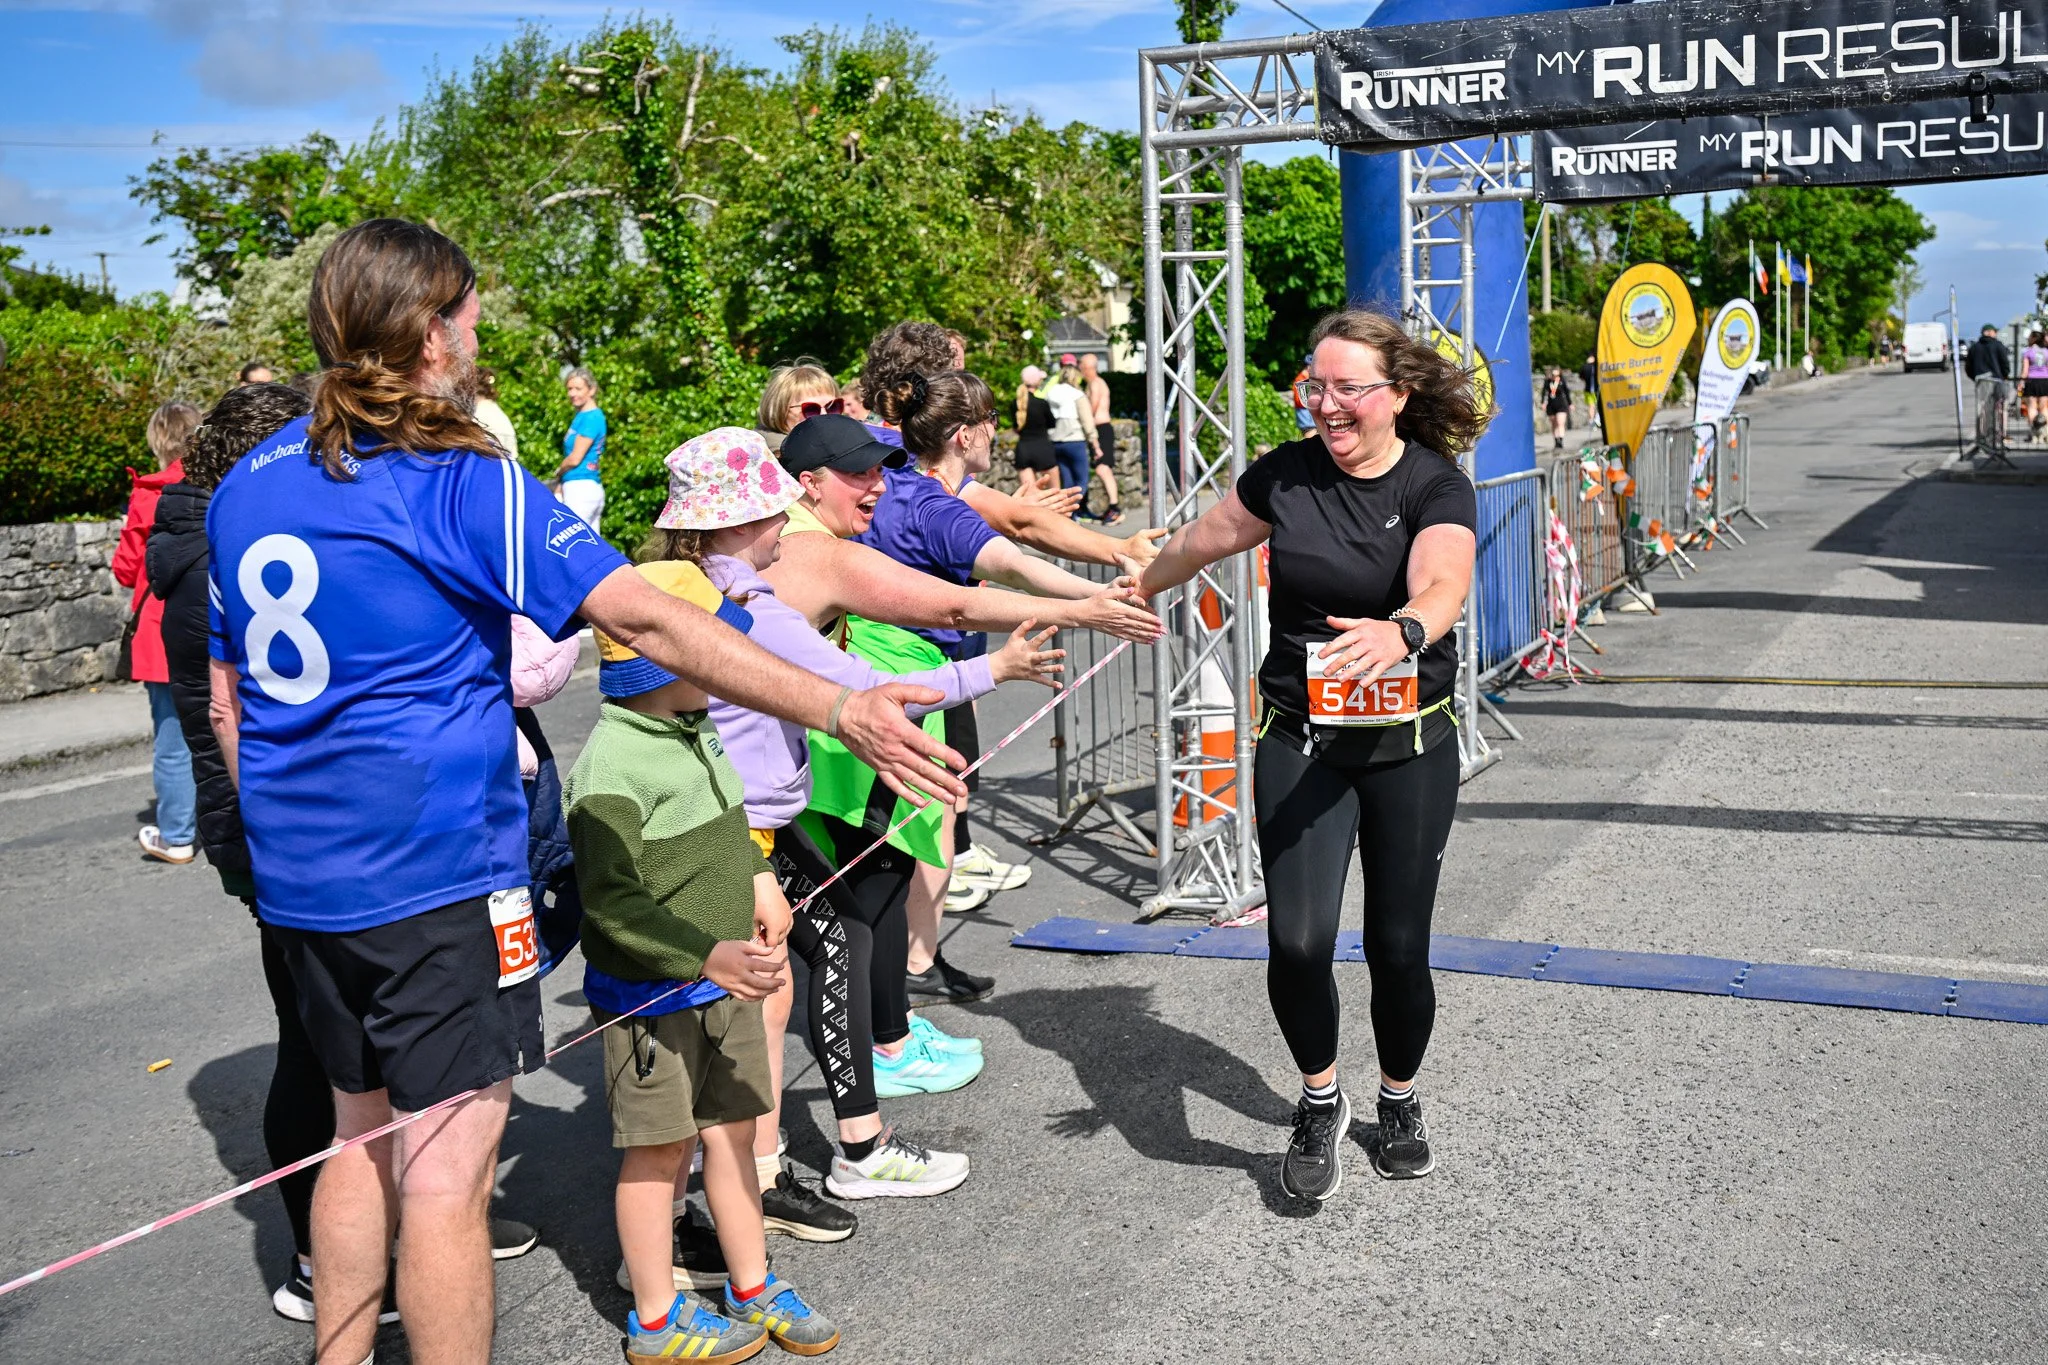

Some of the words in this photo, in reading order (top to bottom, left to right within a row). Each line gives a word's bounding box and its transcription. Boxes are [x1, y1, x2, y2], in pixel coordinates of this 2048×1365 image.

[1536, 50, 1586, 76] MY
[1593, 34, 1756, 98] RUN
[1777, 10, 2048, 83] RESUL
[1340, 71, 1507, 110] RUNNER
[1700, 132, 1737, 152] MY
[1741, 124, 1862, 169] RUN
[1877, 111, 2044, 160] RESU
[1551, 146, 1678, 177] RUNNER
[250, 438, 308, 473] Michael
[238, 533, 331, 705] 8
[1321, 681, 1403, 713] 5415
